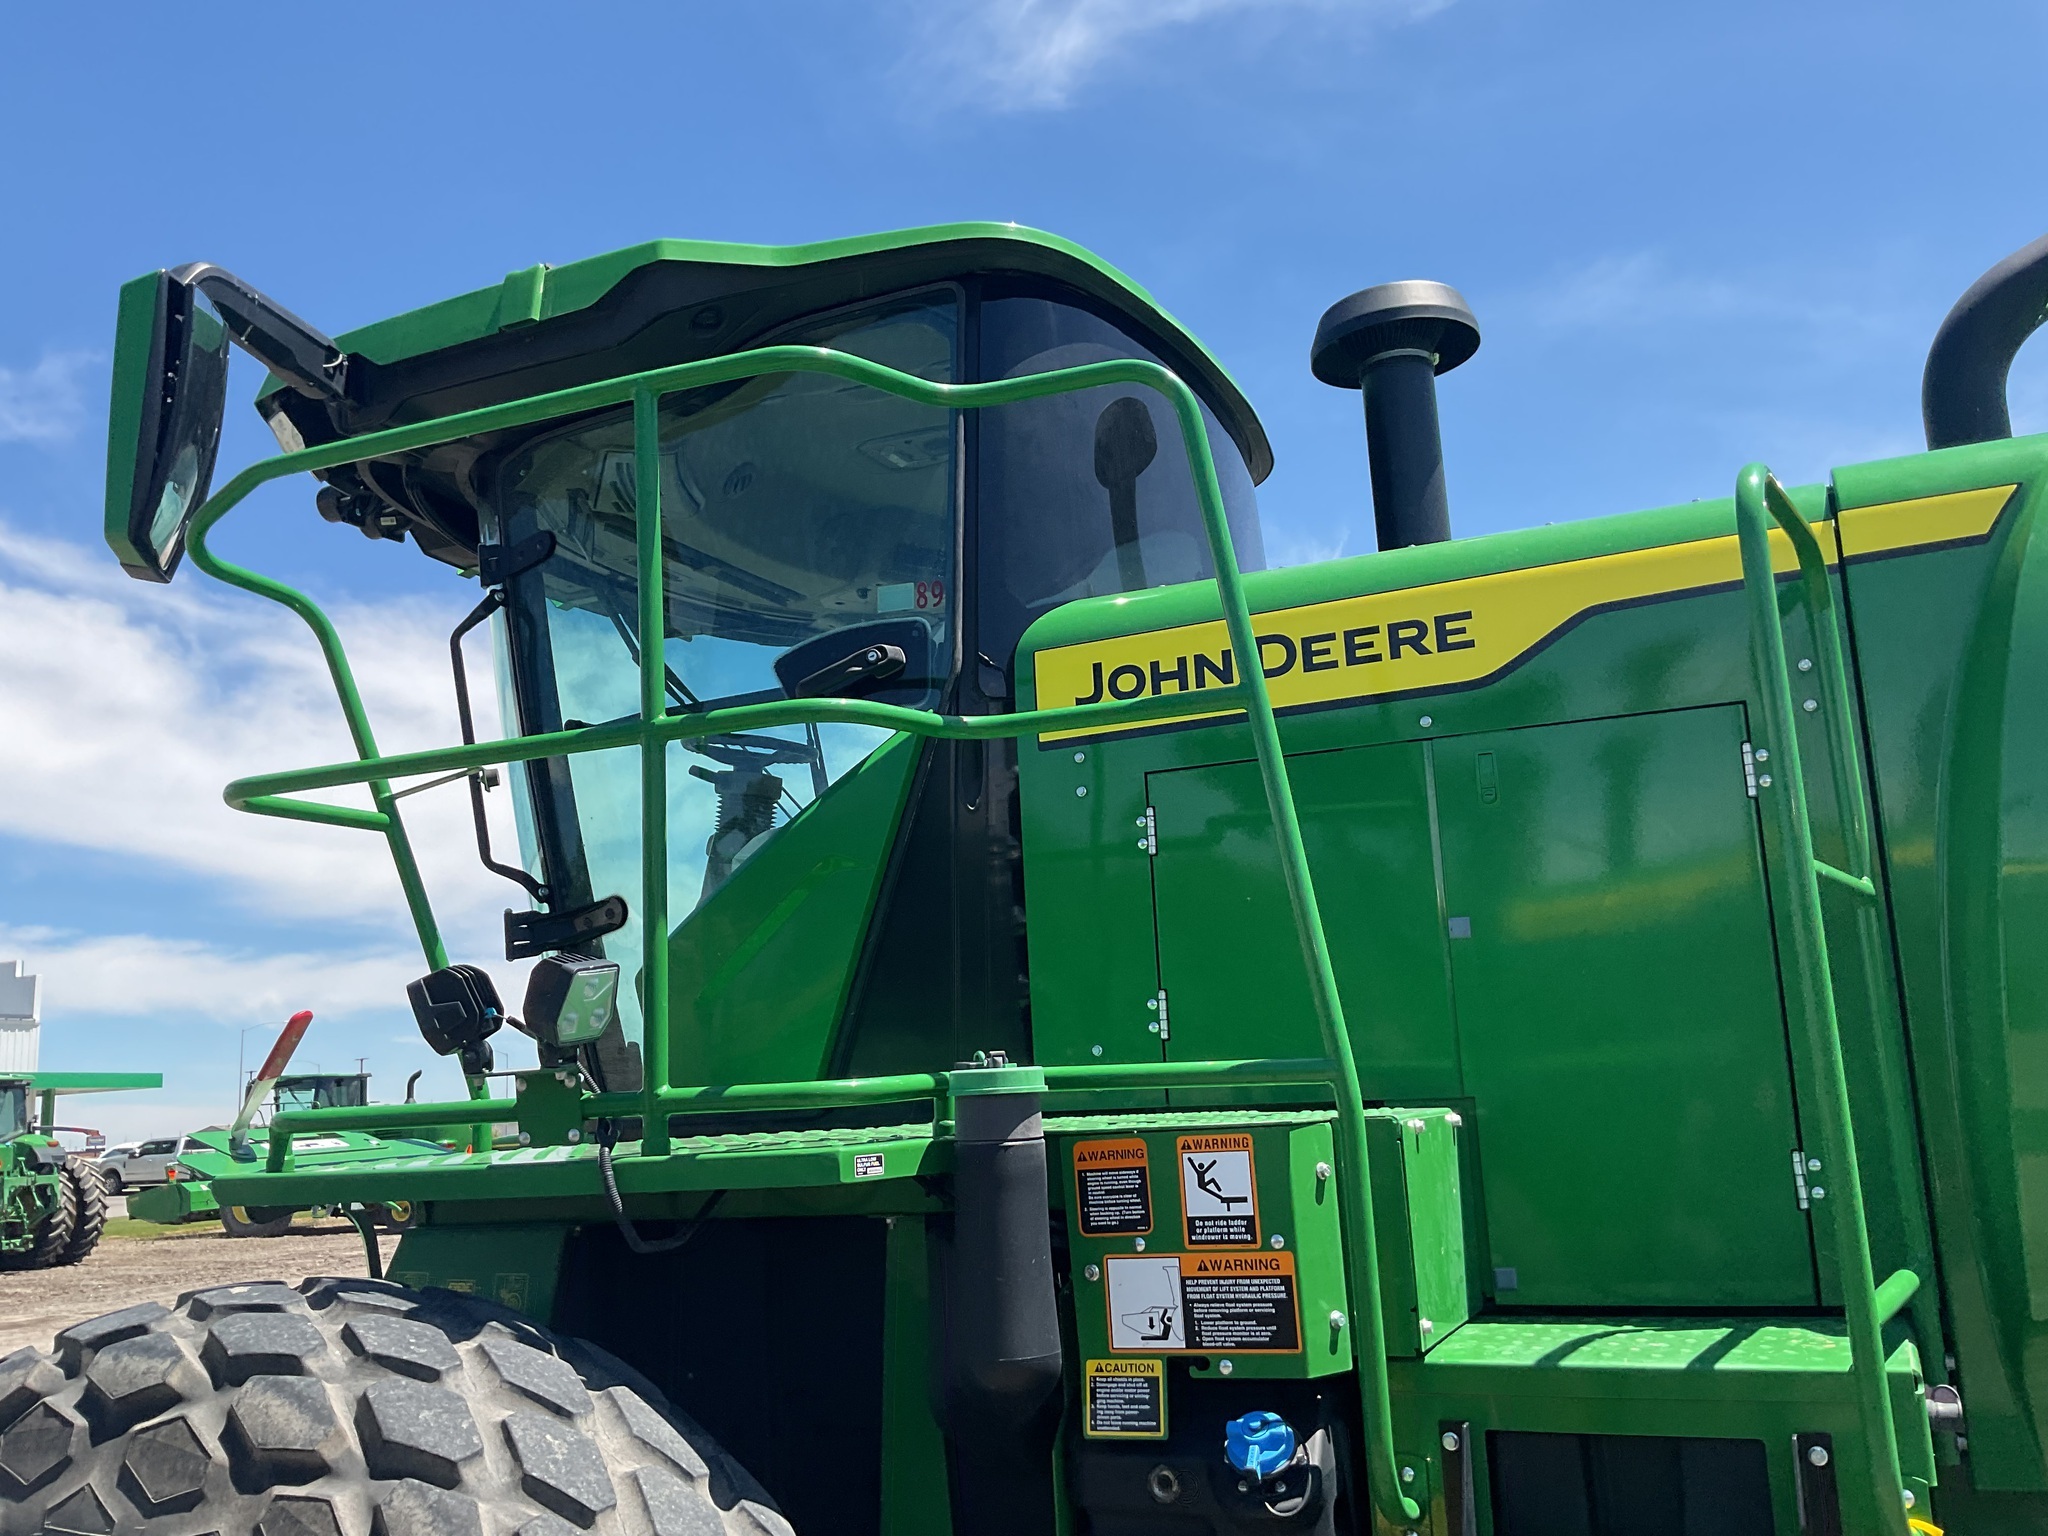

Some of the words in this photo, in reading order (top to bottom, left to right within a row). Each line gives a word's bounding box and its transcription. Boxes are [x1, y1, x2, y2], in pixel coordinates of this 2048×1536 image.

[916, 580, 943, 609] 89
[1075, 650, 1233, 706] JOHN
[1257, 611, 1476, 679] DEERE
[1193, 1137, 1249, 1150] WARNING
[1088, 1149, 1144, 1161] WARNING
[1210, 1258, 1280, 1271] WARNING
[1105, 1363, 1154, 1373] CAUTION
